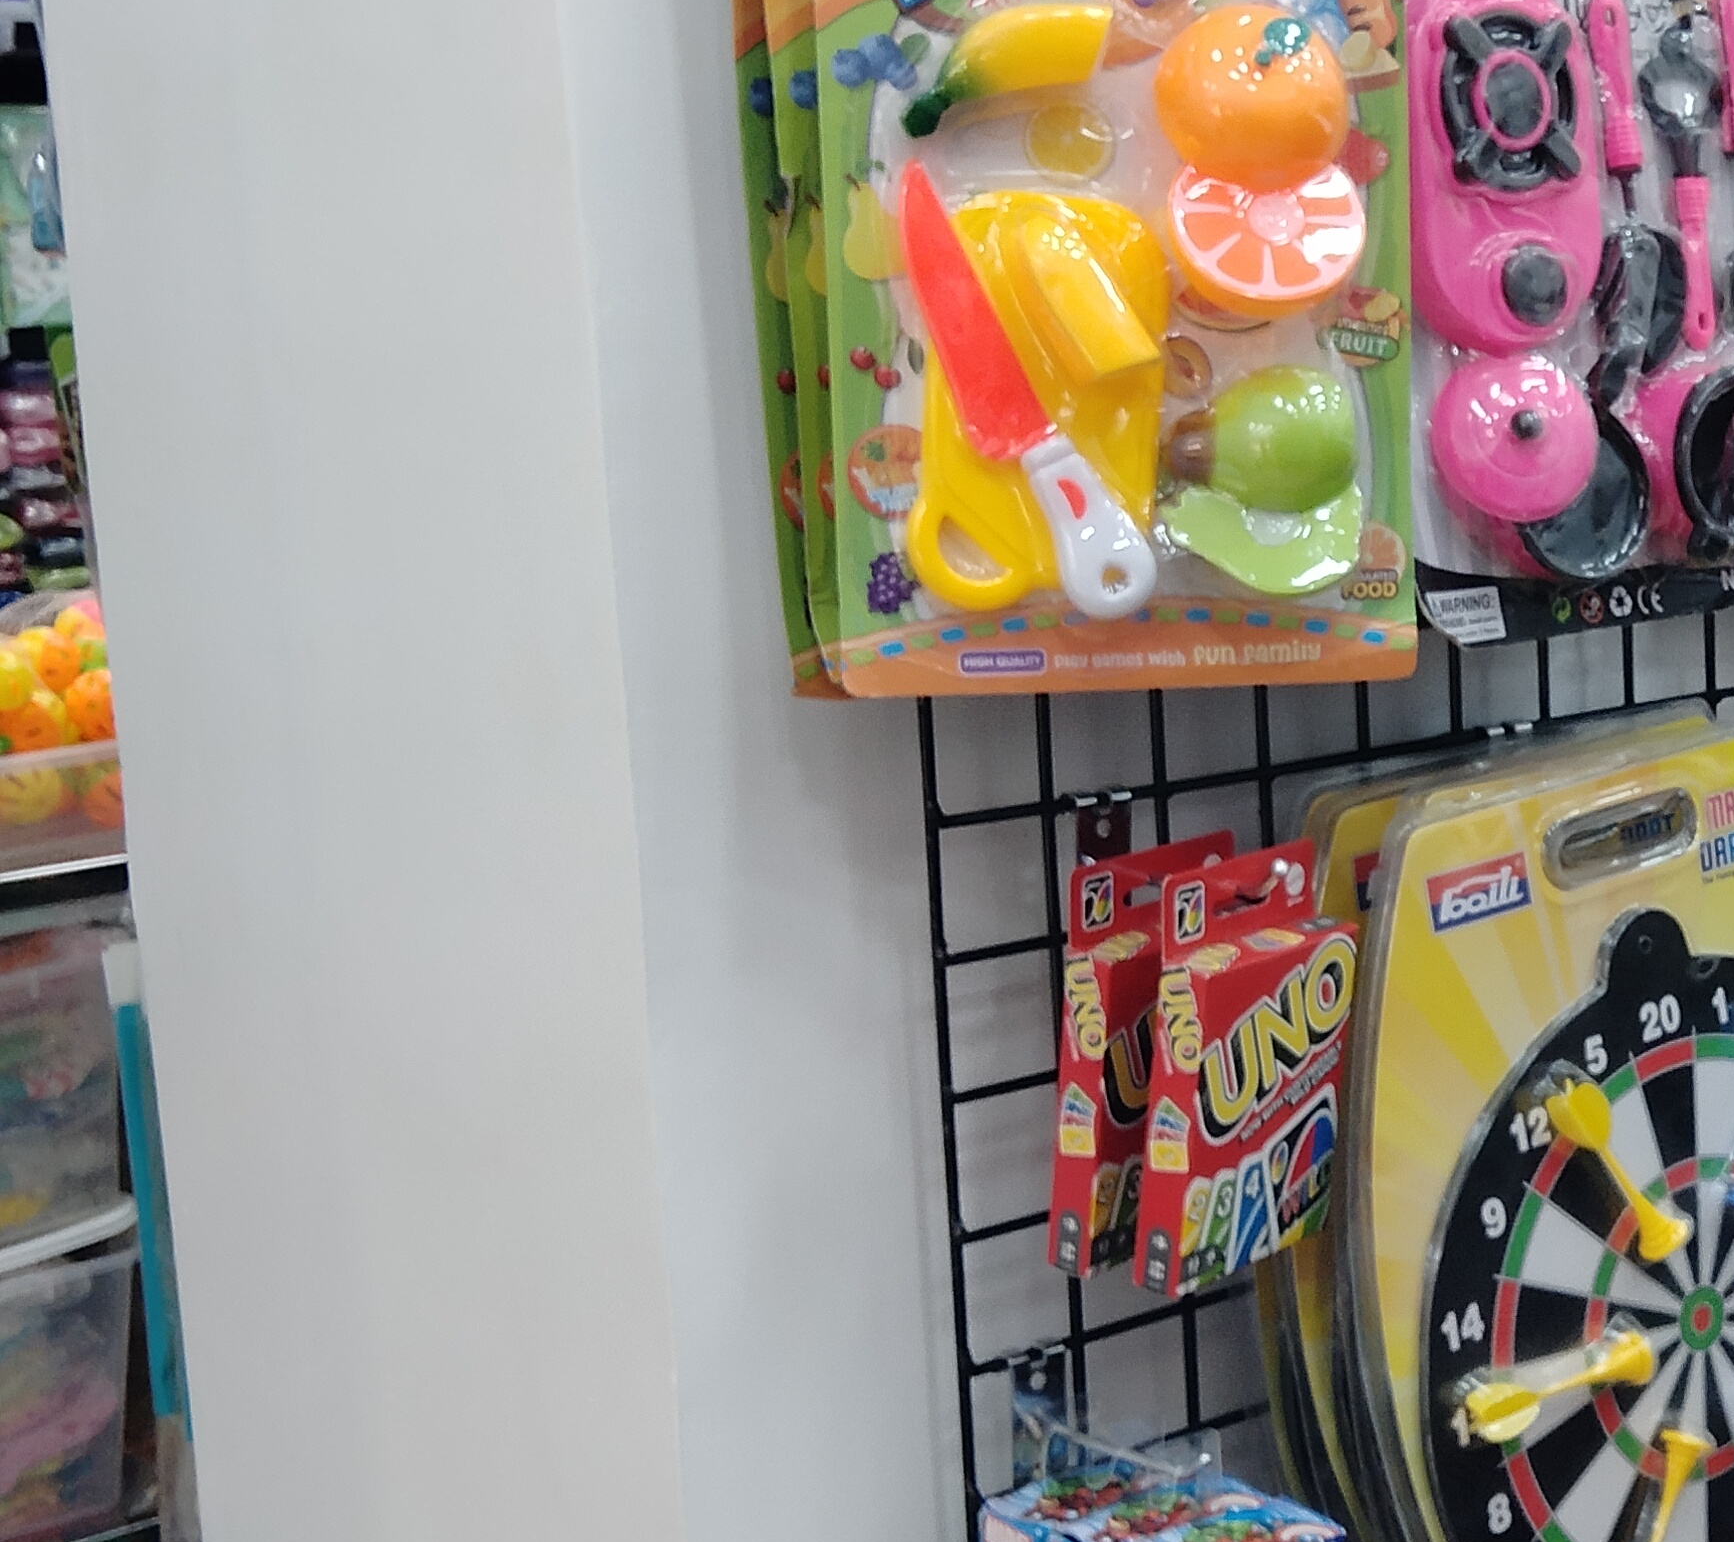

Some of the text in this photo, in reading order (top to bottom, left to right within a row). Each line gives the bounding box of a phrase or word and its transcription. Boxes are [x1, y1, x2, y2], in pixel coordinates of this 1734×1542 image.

[1327, 331, 1388, 357] FRUIT
[1064, 959, 1107, 1061] UNO
[1158, 969, 1202, 1074] UNO
[1639, 993, 1681, 1043] 20
[1711, 987, 1729, 1025] 1
[1200, 931, 1358, 1149] UNO
[1584, 1035, 1608, 1075] 5
[1509, 1105, 1554, 1154] 12
[1216, 1185, 1234, 1218] 3
[1245, 1168, 1262, 1200] 4
[1481, 1197, 1507, 1238] 9
[1441, 1302, 1485, 1352] 14
[1487, 1493, 1513, 1534] 8
